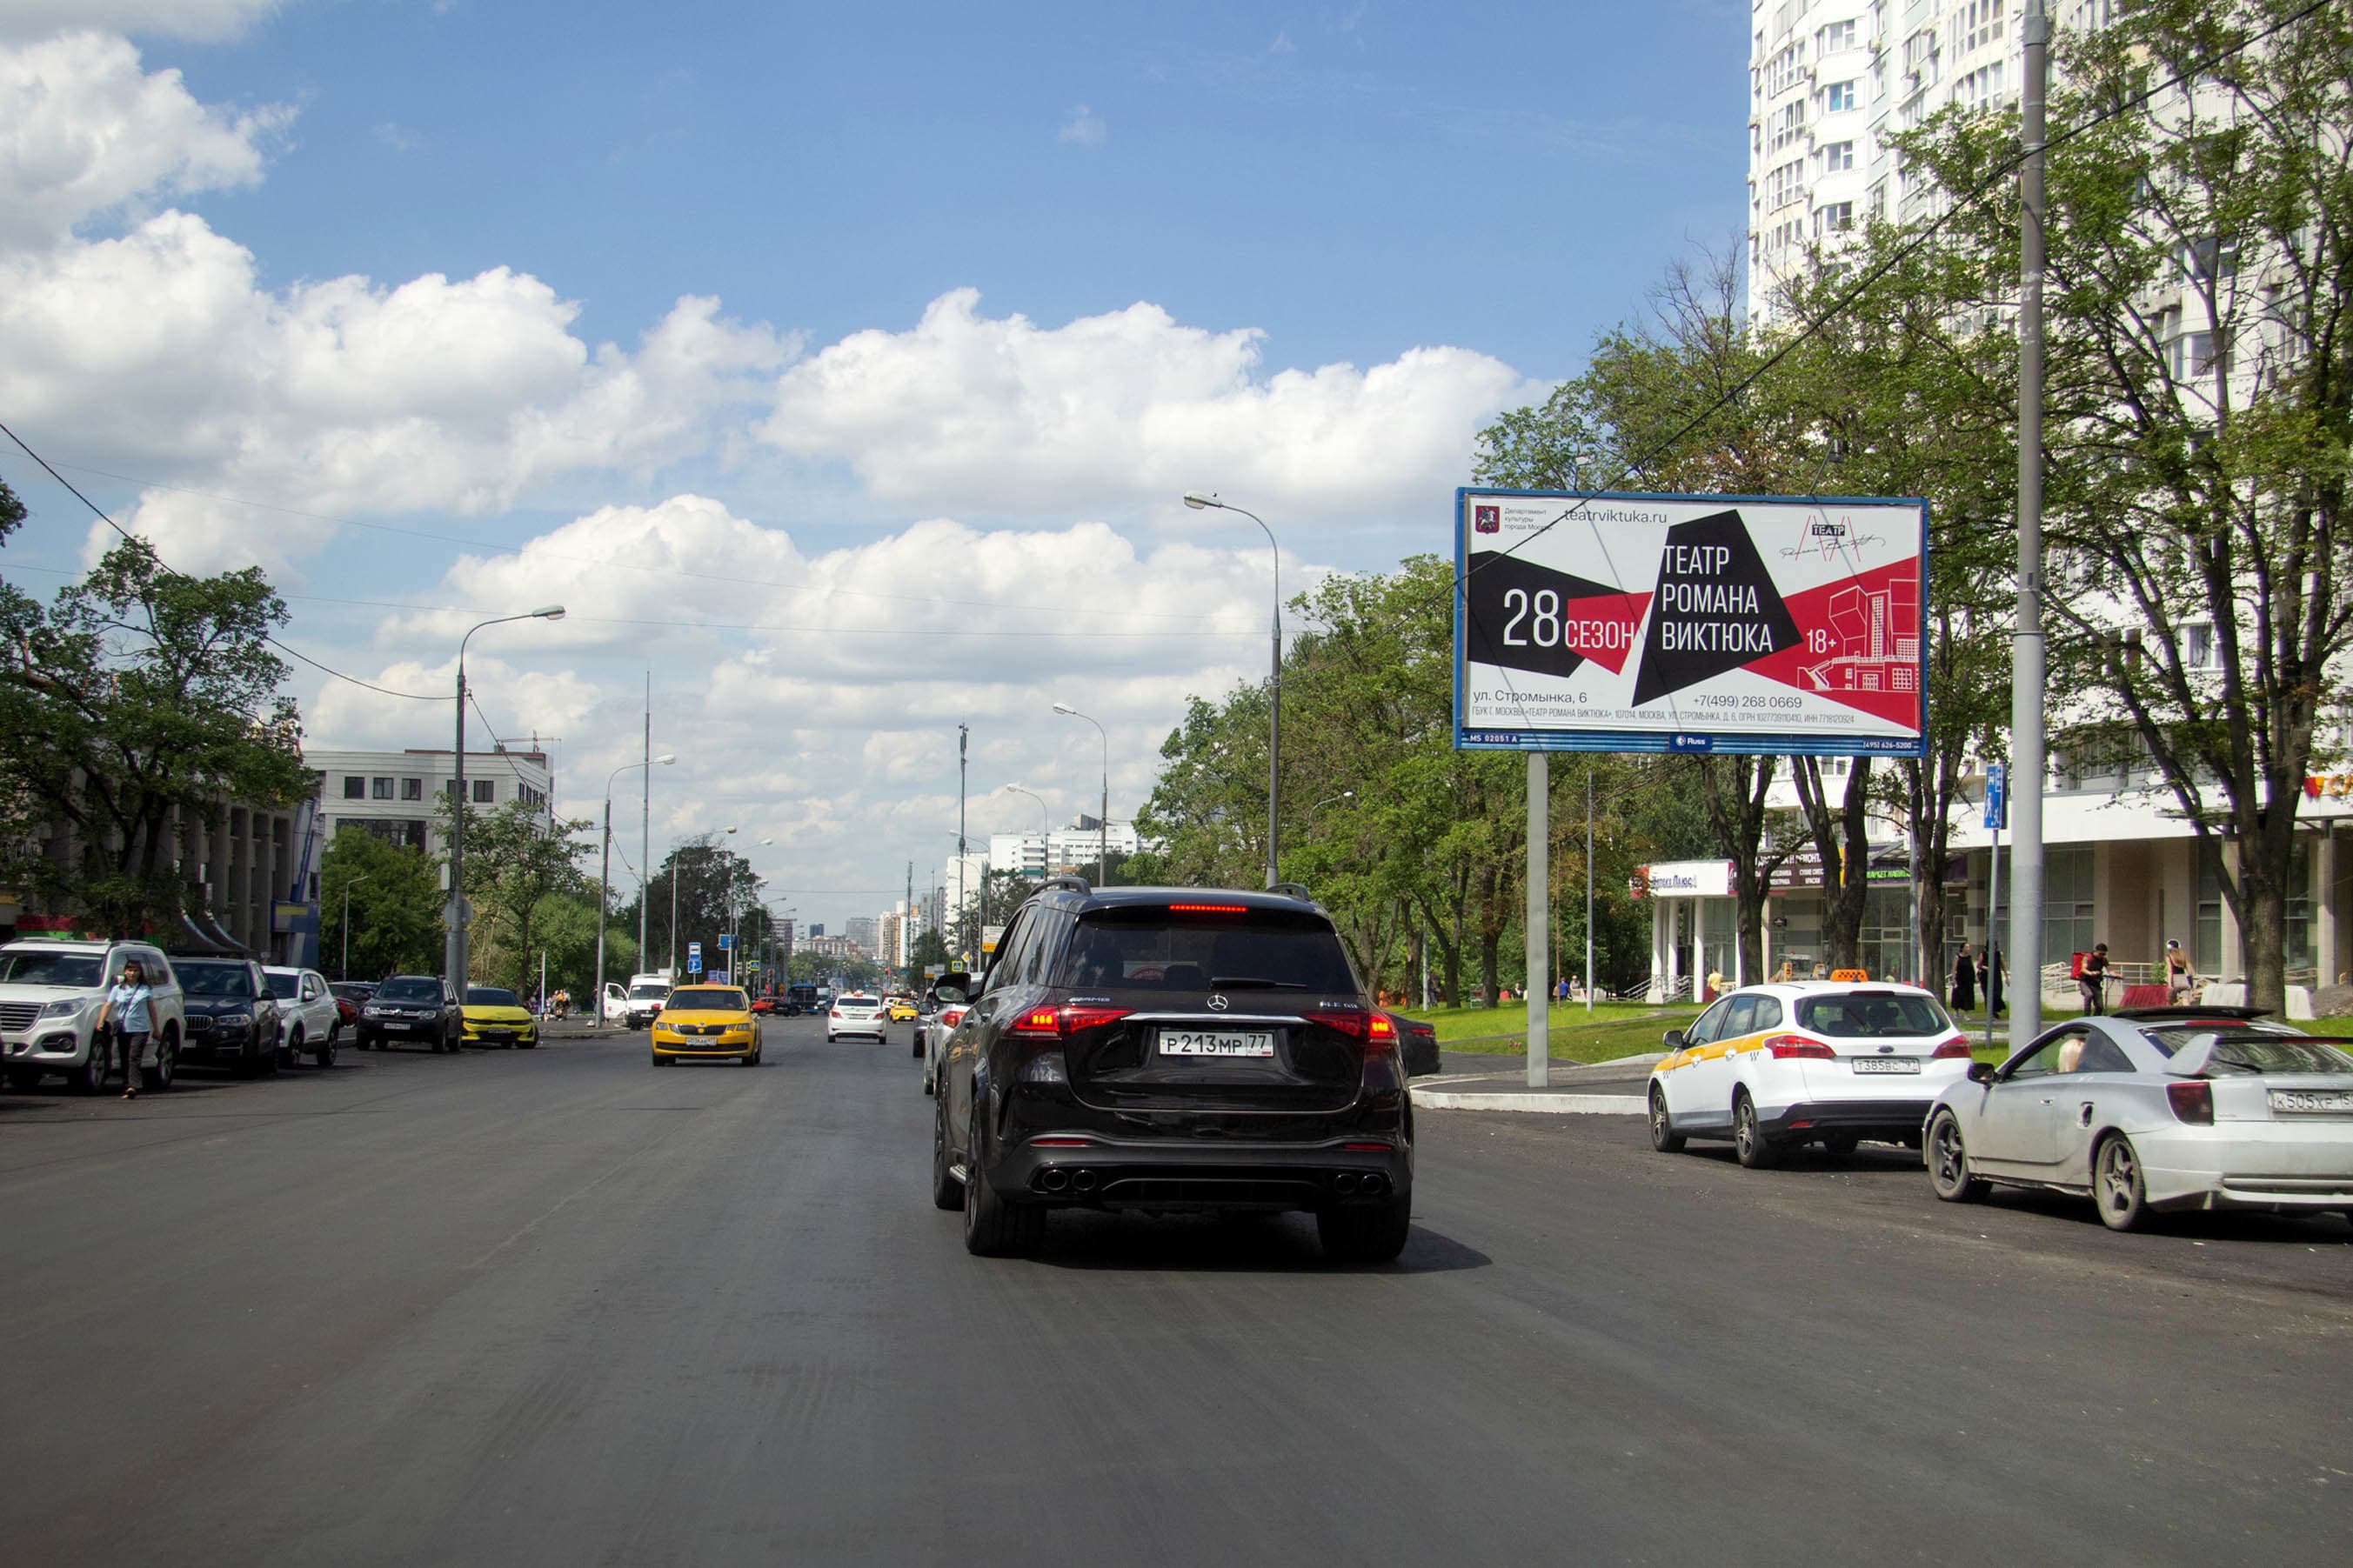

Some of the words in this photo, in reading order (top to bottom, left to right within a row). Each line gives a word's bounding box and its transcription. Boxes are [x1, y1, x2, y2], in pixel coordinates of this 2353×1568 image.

[1565, 509, 1667, 524] teatrviktuka.ru
[1814, 525, 1844, 535] ТЕАТР
[1663, 545, 1729, 575] ТЕАТР
[1662, 584, 1759, 614] РОМАНА
[1503, 589, 1560, 647] 28
[1565, 620, 1636, 649] СЕЗОН
[1662, 622, 1773, 652] ВИКТЮКА
[1807, 629, 1837, 653] 18+
[1474, 691, 1491, 703] ул.
[1495, 690, 1575, 704] Стромынка,
[1579, 691, 1588, 704] 6
[1694, 696, 1739, 709] +7(499)
[1741, 696, 1767, 707] 268
[1768, 697, 1802, 708] 0669
[1549, 708, 1576, 717] РОМАНА
[1248, 1035, 1267, 1049] 77
